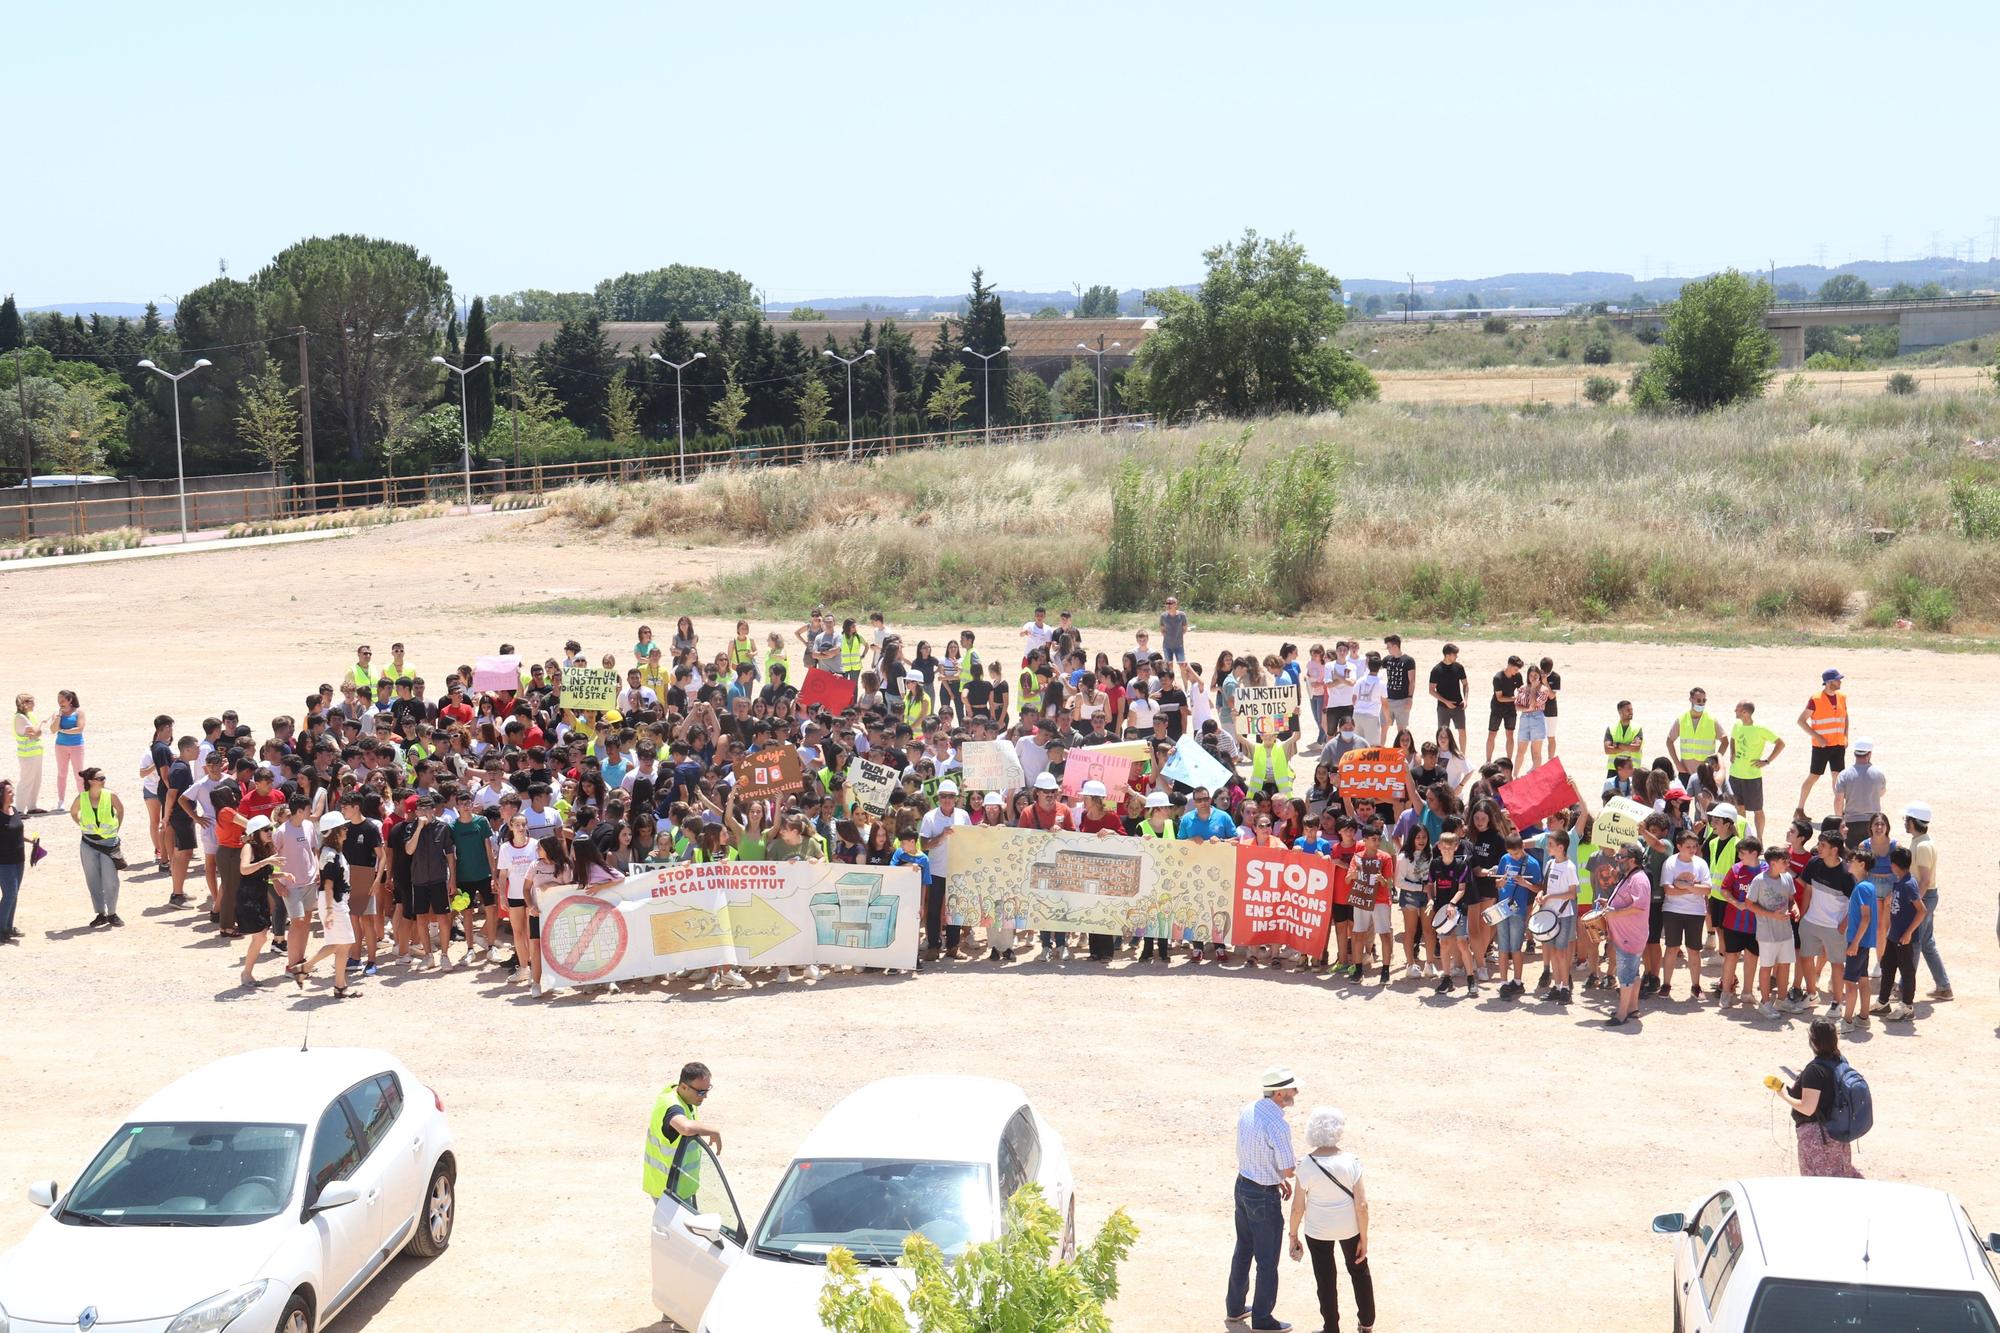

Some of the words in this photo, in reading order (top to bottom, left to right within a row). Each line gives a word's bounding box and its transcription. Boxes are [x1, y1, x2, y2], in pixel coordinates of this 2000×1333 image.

[563, 668, 598, 677] VOLEM
[604, 670, 616, 678] UN
[570, 676, 615, 685] INSTITUT
[572, 691, 606, 700] NOSTRE
[1237, 688, 1250, 700] UN
[1239, 703, 1258, 716] AMB
[1262, 701, 1286, 715] TOTES
[1359, 749, 1379, 761] SOM
[860, 760, 884, 776] VOLEM
[1342, 763, 1402, 773] PROU
[1340, 777, 1405, 791] LLAUNES
[658, 867, 693, 884] STOP
[696, 865, 776, 877] BARRACONS
[1246, 860, 1328, 894] STOP
[651, 885, 677, 898] ENS
[680, 881, 705, 893] CAL
[1242, 888, 1327, 913] BARRACONS
[1245, 904, 1273, 918] ENS
[1276, 905, 1300, 921] CAL
[1301, 912, 1321, 927] UN
[1252, 919, 1312, 940] INSTITUT
